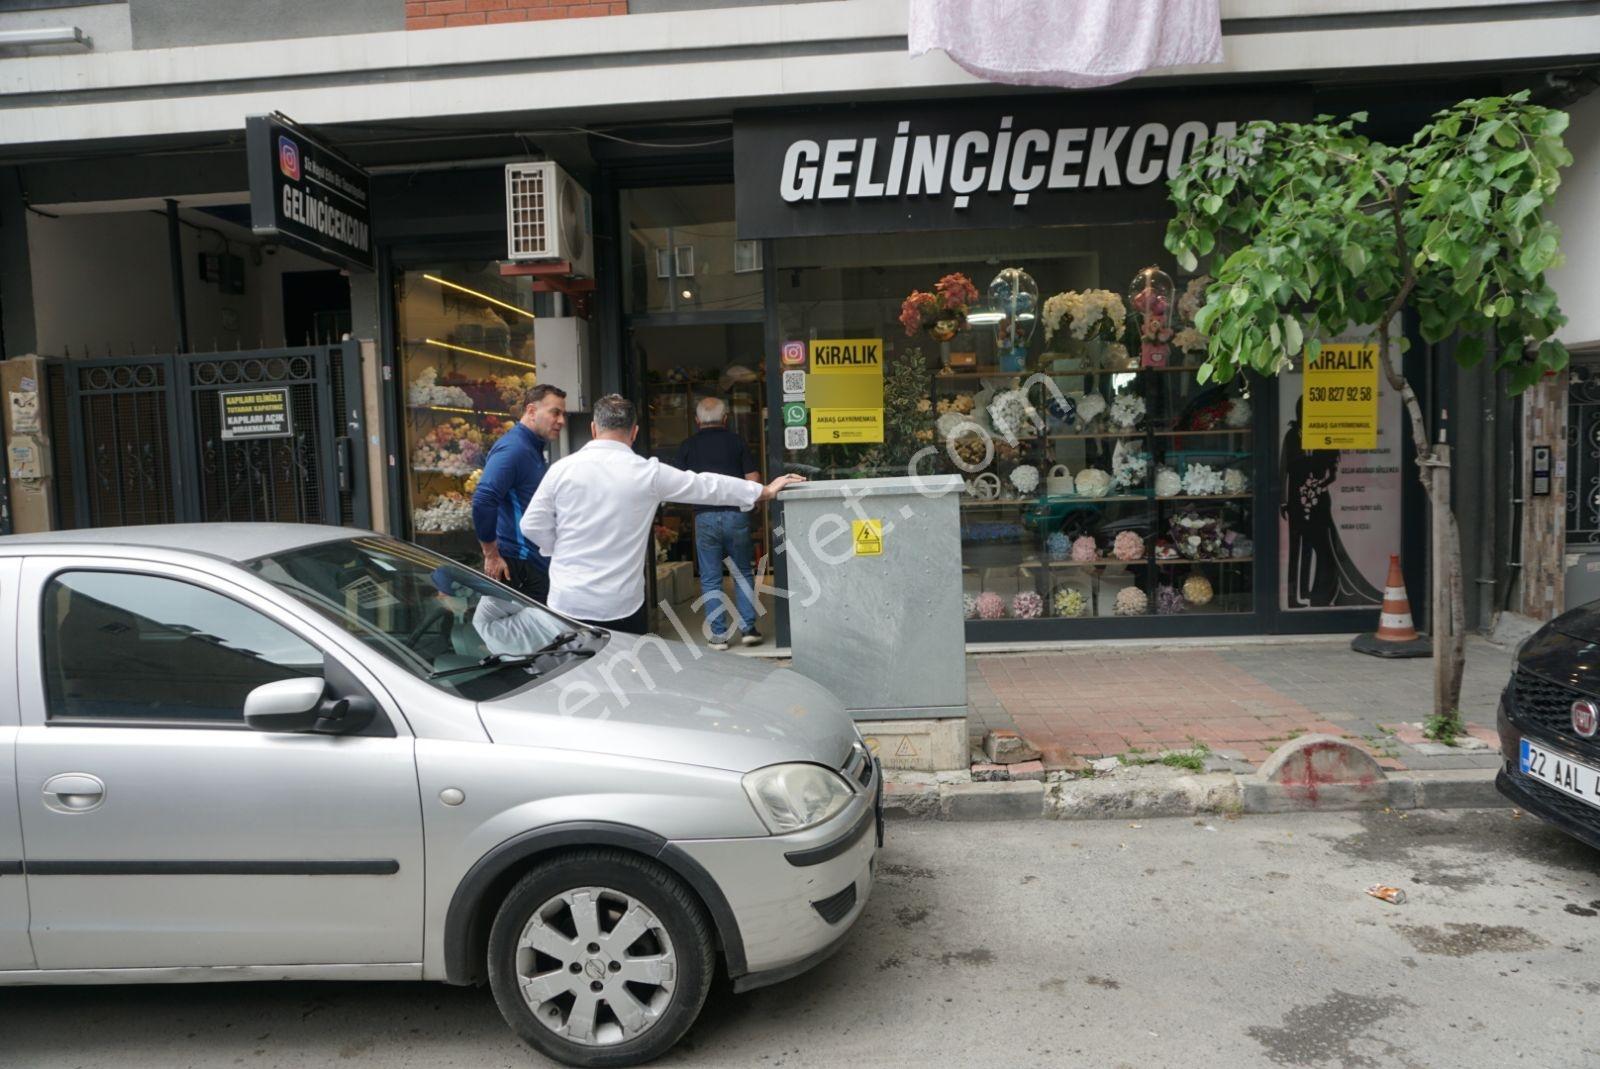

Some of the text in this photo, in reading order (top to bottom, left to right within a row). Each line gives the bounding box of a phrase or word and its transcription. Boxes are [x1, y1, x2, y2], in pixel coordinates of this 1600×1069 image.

[1309, 386, 1372, 402] 530 827 92 58
[227, 413, 285, 424] KAPILARI AÇIK
[816, 416, 837, 424] AKBAŞ
[1530, 748, 1546, 778] 22
[1555, 760, 1583, 795] AAL
